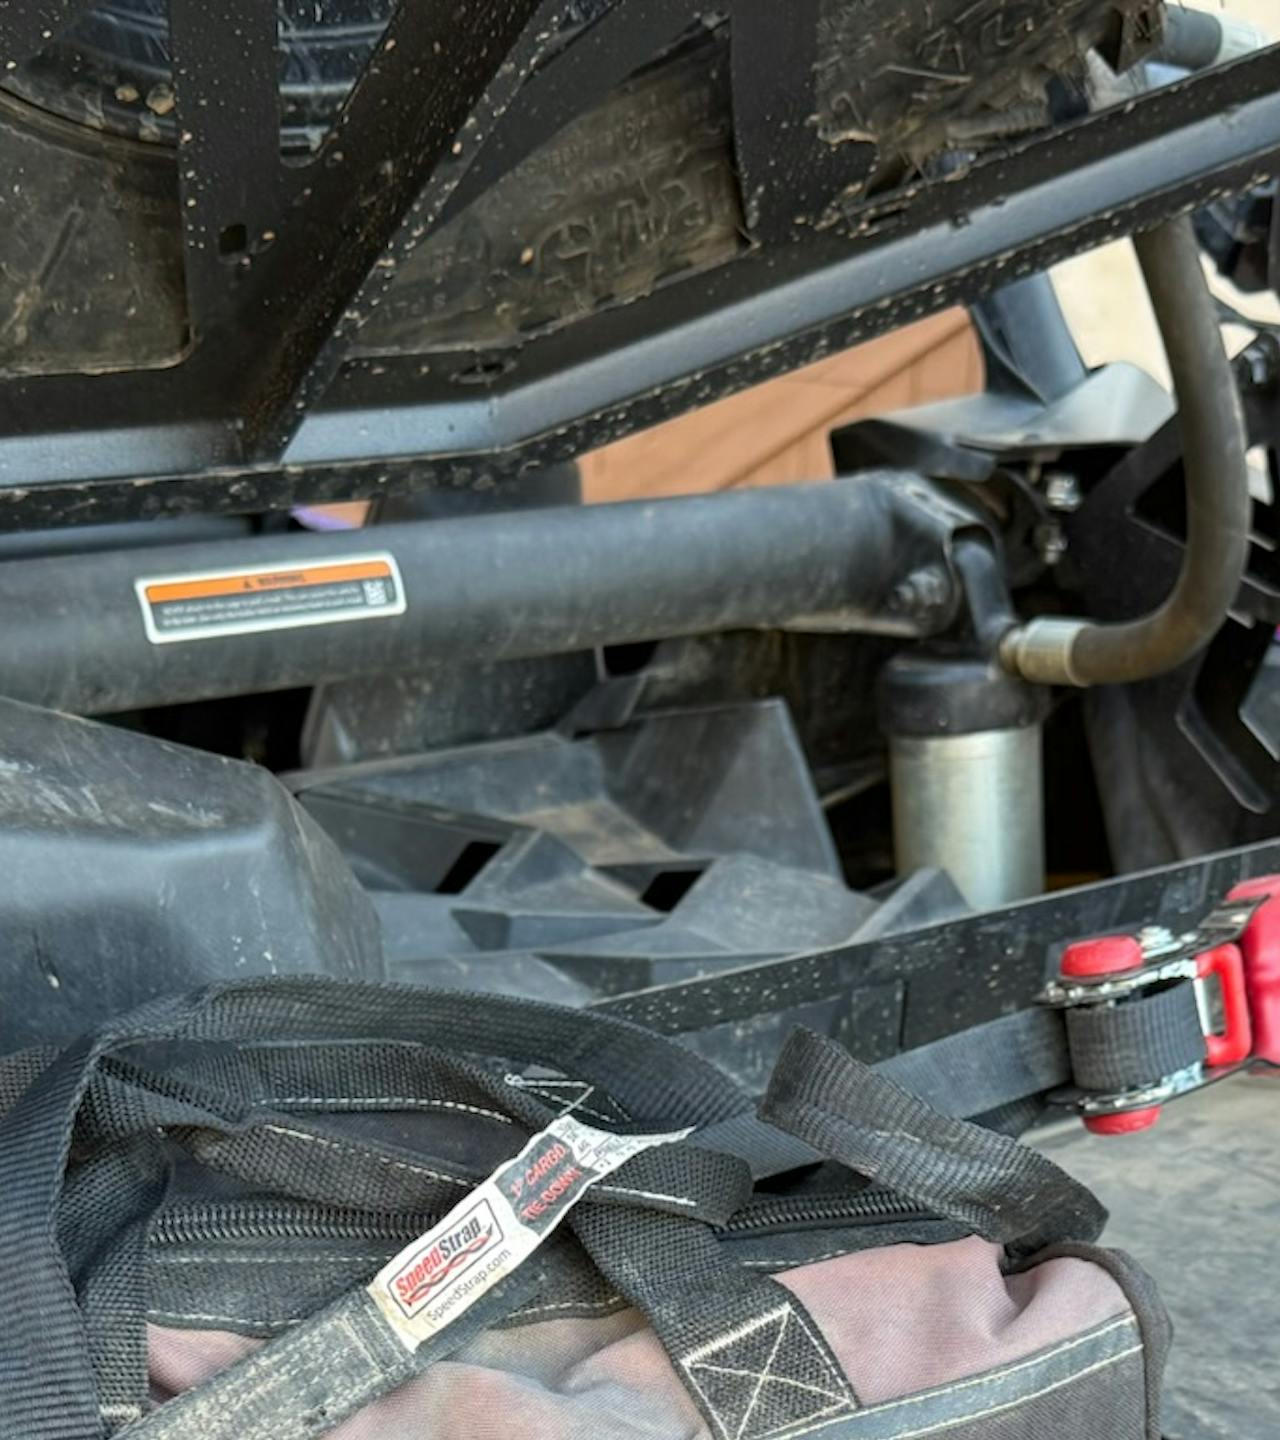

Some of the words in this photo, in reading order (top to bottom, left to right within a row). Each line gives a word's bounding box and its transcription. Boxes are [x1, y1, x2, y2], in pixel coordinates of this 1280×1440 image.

[525, 1142, 567, 1187] CARGO
[395, 1216, 484, 1300] SpeedStrap
[426, 1248, 512, 1322] SpeedStrap.com
